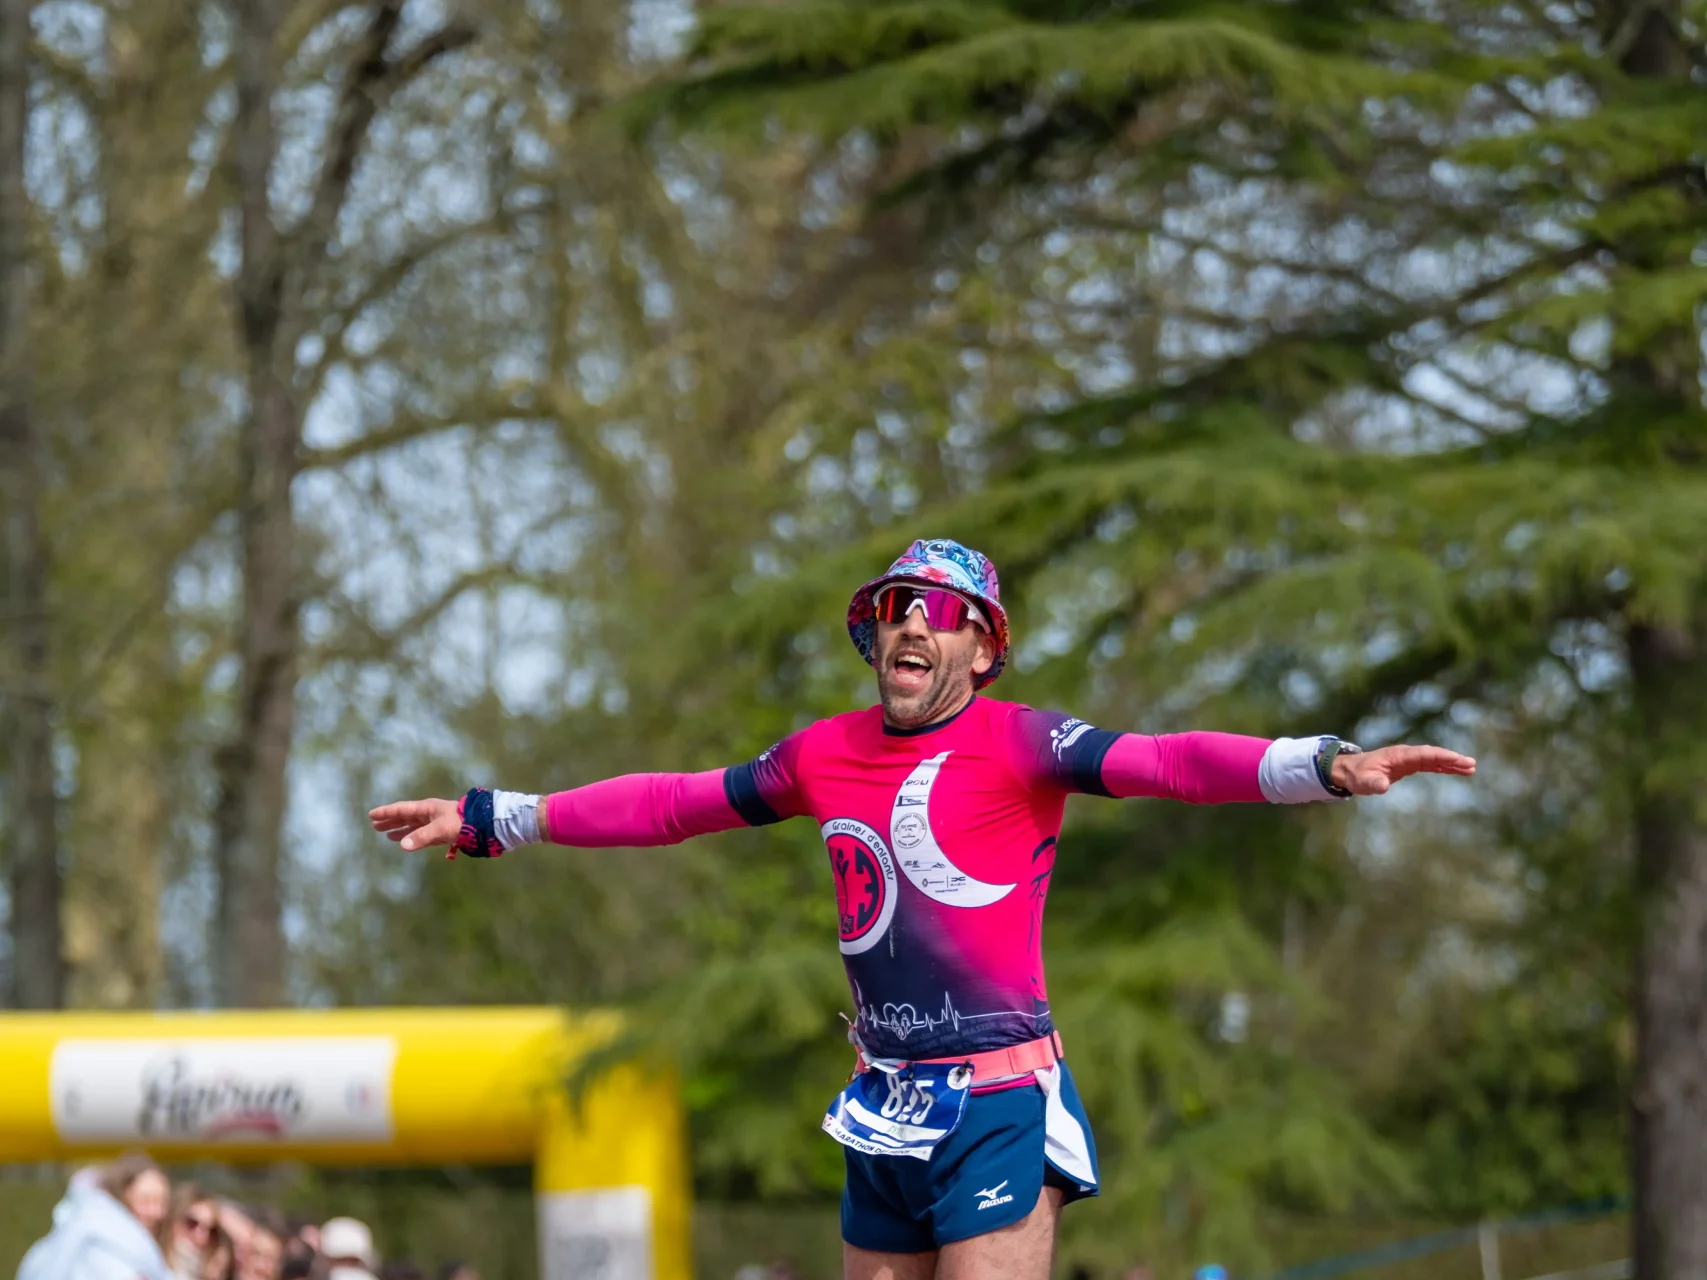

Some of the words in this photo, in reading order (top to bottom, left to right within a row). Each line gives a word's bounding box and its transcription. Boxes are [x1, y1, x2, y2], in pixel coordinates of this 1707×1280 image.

[832, 821, 866, 836] Graines
[867, 834, 894, 881] d'enfants
[881, 1072, 934, 1125] 825
[832, 1128, 875, 1154] MARATHON
